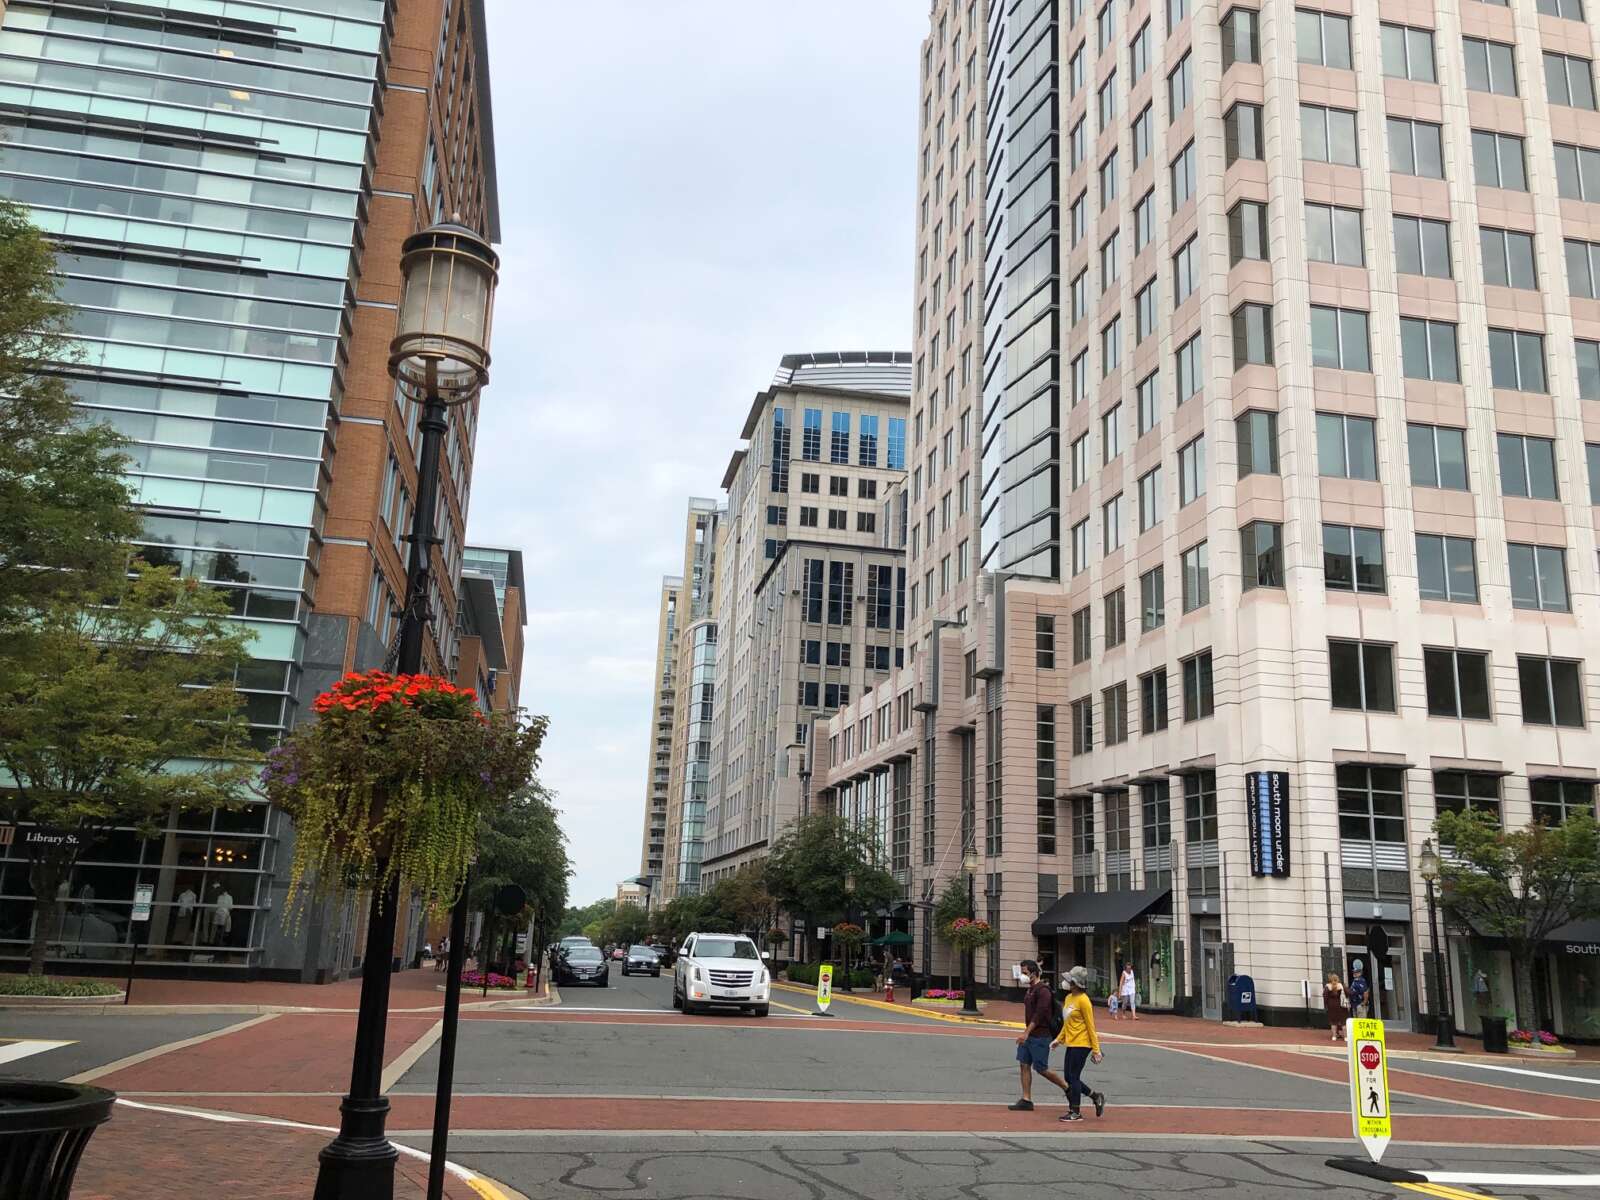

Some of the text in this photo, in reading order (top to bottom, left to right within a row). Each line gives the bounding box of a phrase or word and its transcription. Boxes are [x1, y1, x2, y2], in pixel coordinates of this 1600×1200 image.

[1272, 773, 1285, 873] south moon under
[26, 832, 80, 845] Library St.
[1566, 943, 1600, 954] south
[1358, 1021, 1378, 1030] STATE
[1361, 1030, 1376, 1038] LAW
[1361, 1051, 1379, 1063] STOP
